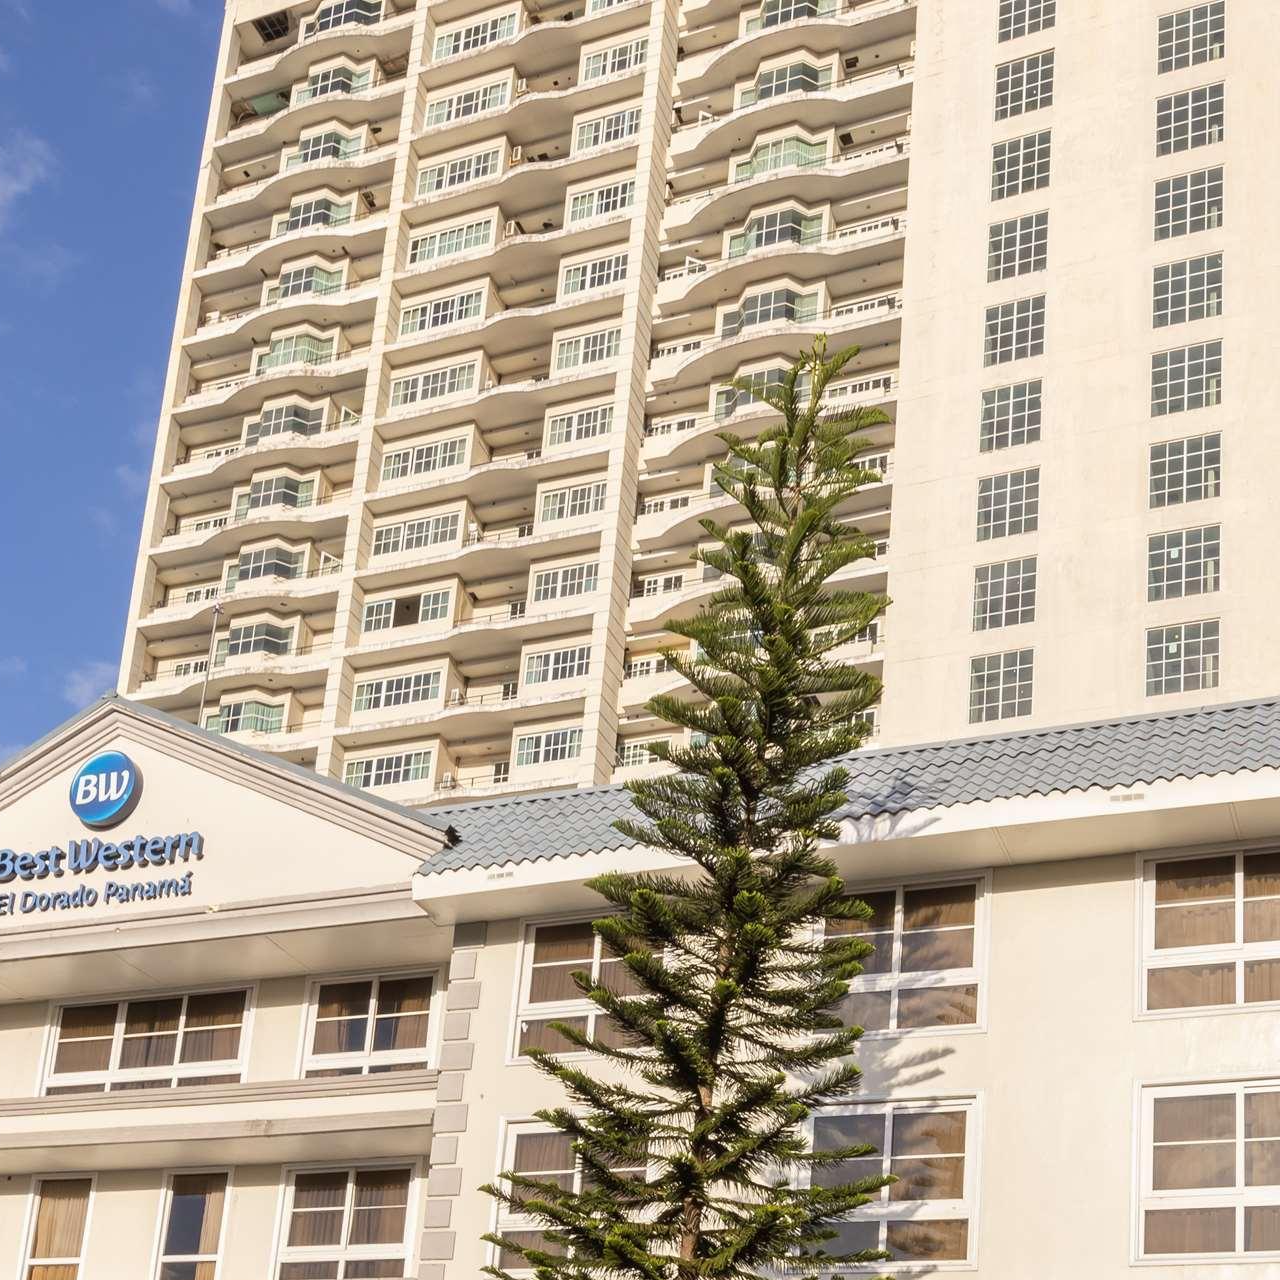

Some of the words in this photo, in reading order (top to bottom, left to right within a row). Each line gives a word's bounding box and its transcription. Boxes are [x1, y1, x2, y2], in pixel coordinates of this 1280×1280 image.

[76, 769, 130, 805] BW
[68, 831, 204, 873] Western
[20, 883, 98, 913] Dorado
[104, 871, 194, 904] Panamá
